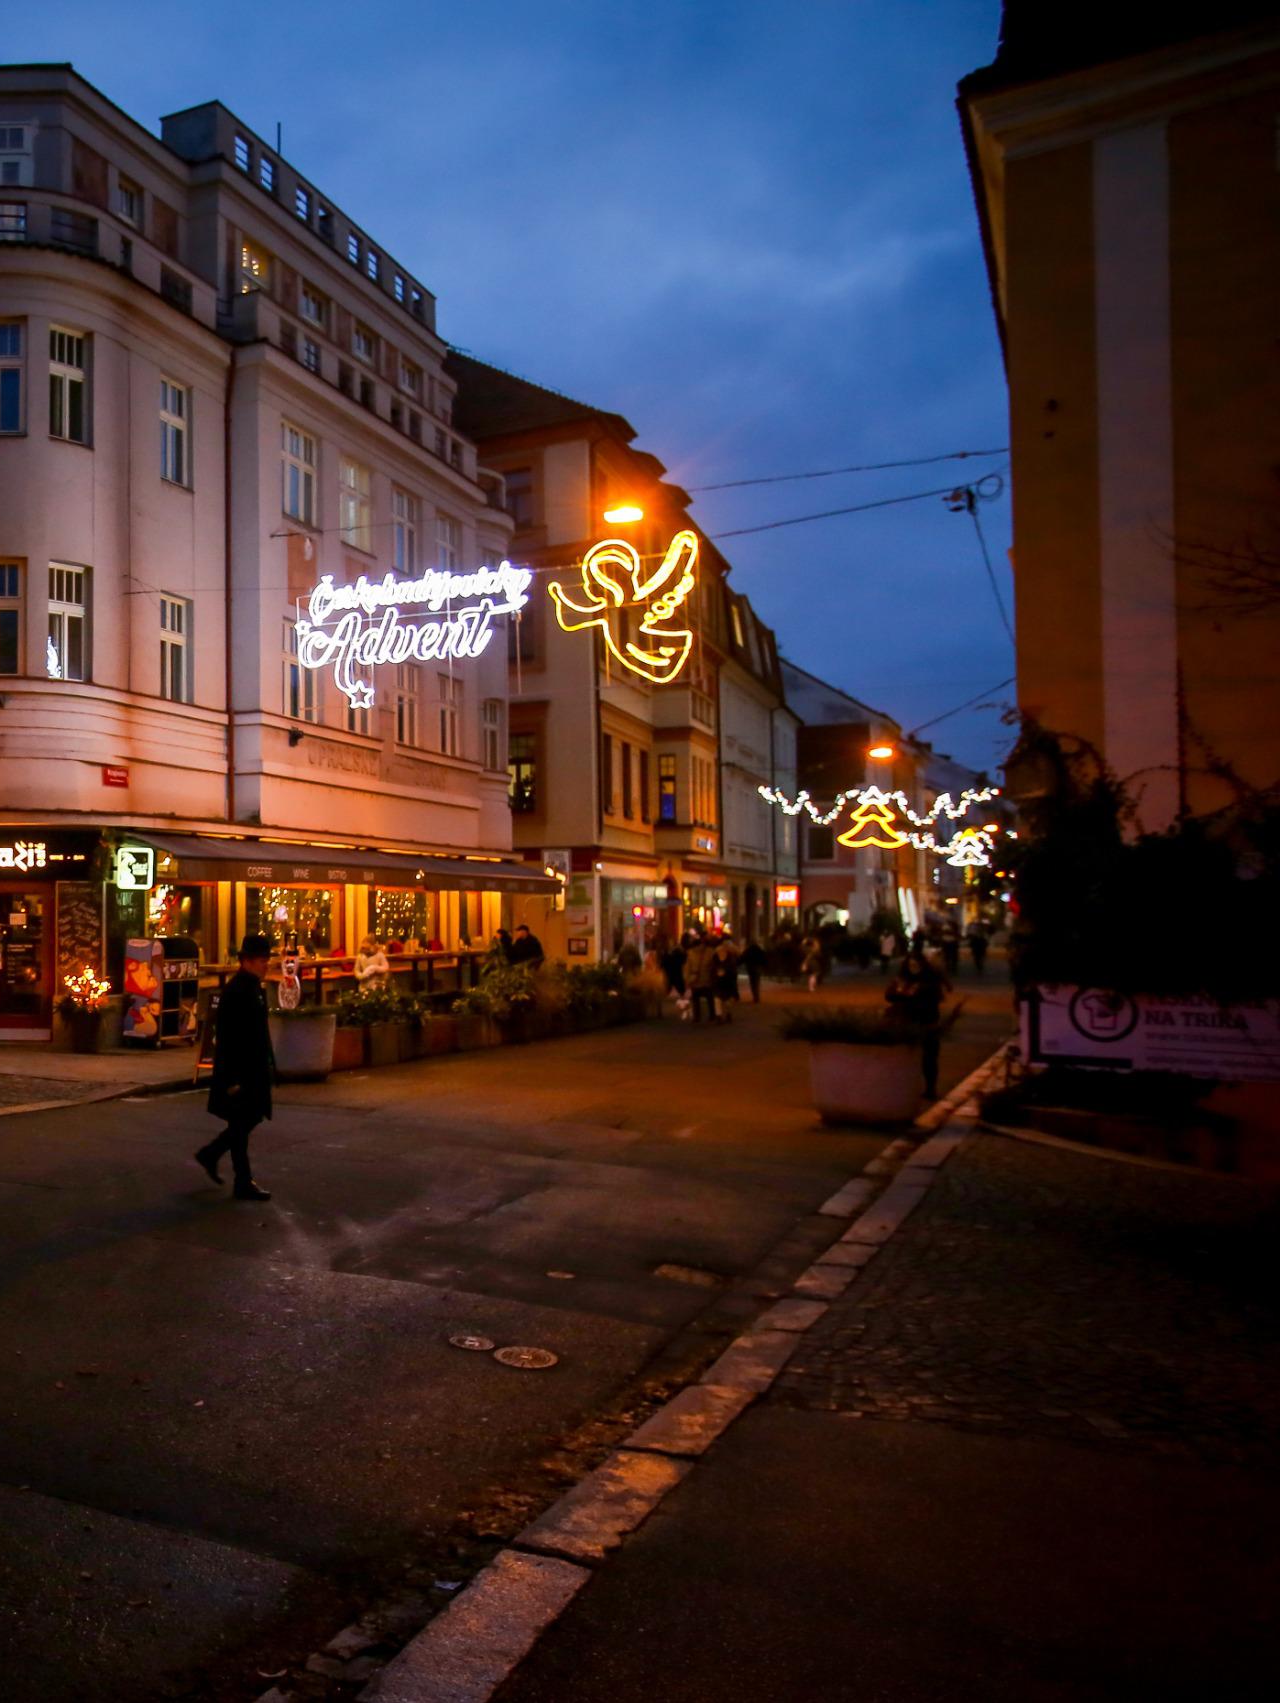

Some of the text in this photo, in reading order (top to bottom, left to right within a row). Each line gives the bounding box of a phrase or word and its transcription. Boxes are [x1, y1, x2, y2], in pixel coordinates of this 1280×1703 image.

[299, 601, 498, 690] Advent
[247, 866, 273, 878] COFFEE
[292, 868, 310, 879] WINE
[327, 870, 347, 880] BISTRO
[1145, 1010, 1176, 1026] NA
